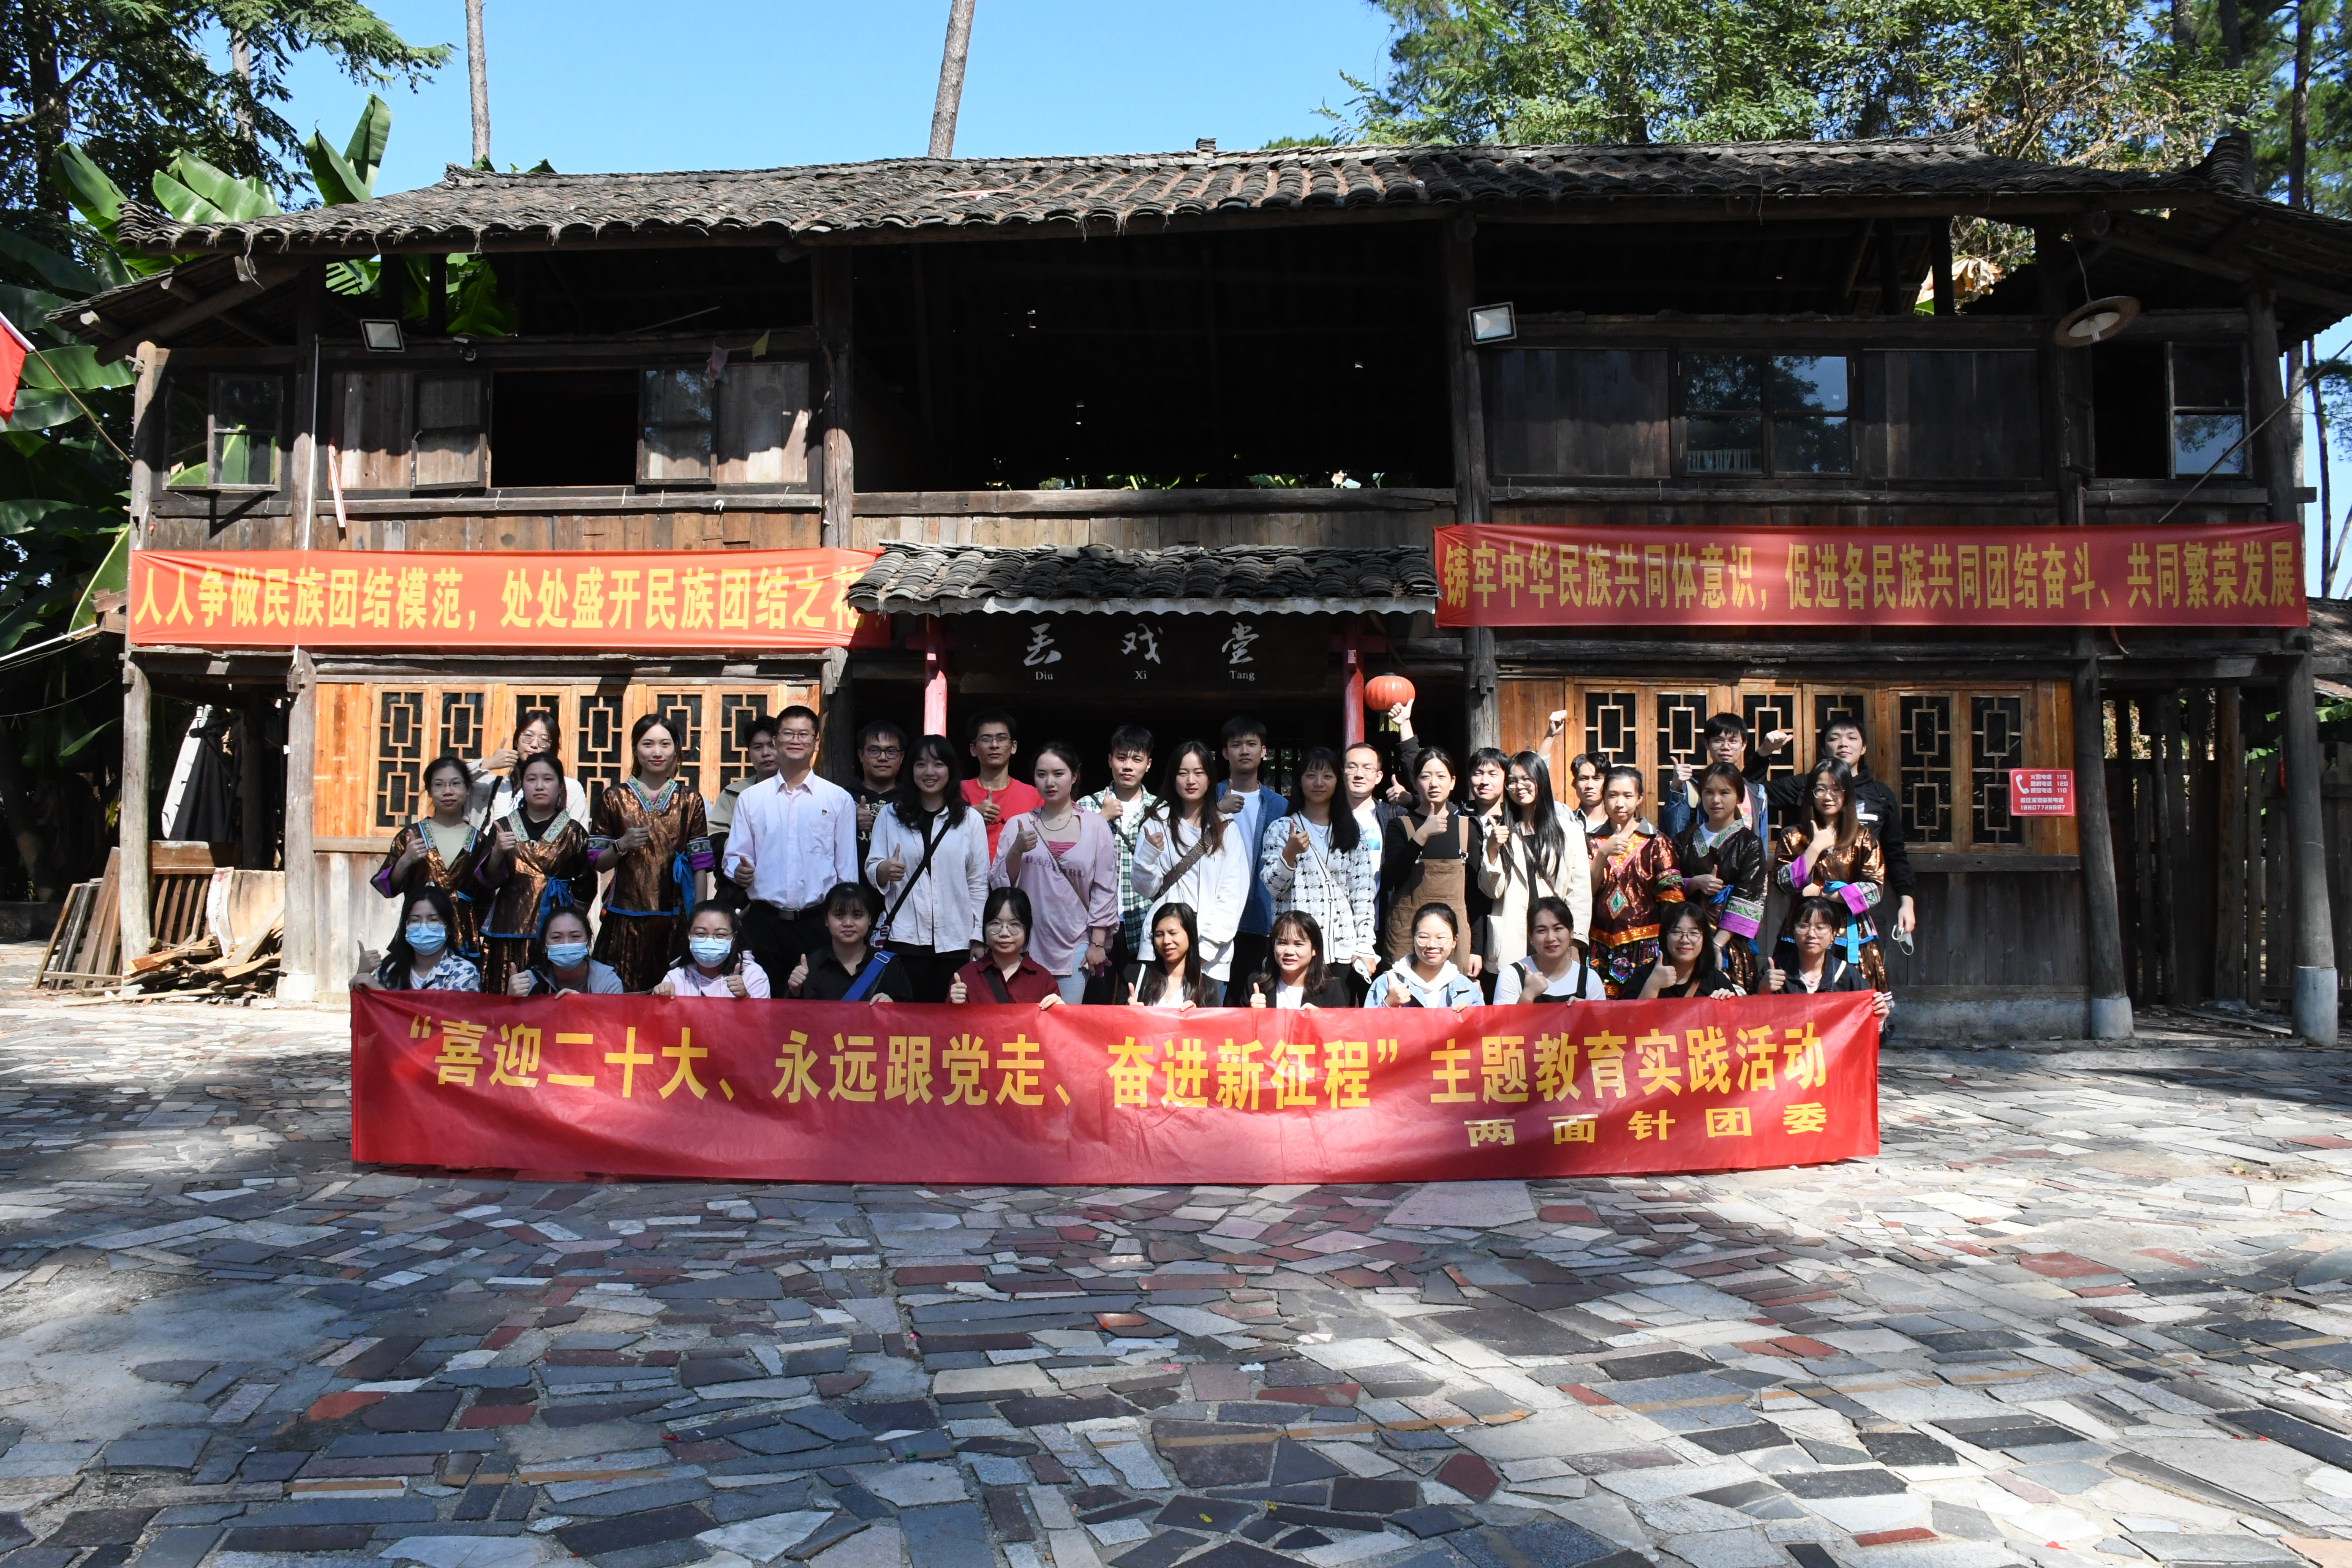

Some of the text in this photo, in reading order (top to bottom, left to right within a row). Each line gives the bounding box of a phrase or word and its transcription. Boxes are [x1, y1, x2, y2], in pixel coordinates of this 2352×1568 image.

[134, 565, 880, 632] 人人争做民族团结模范，处处盛开民族团结之花
[1035, 670, 1255, 681] Diu Xi Tang
[410, 1016, 1827, 1109] “喜迎二十大、永远跟党走、奋进新征程”主题教育实践活动
[1464, 1102, 1827, 1147] 两面针团委
